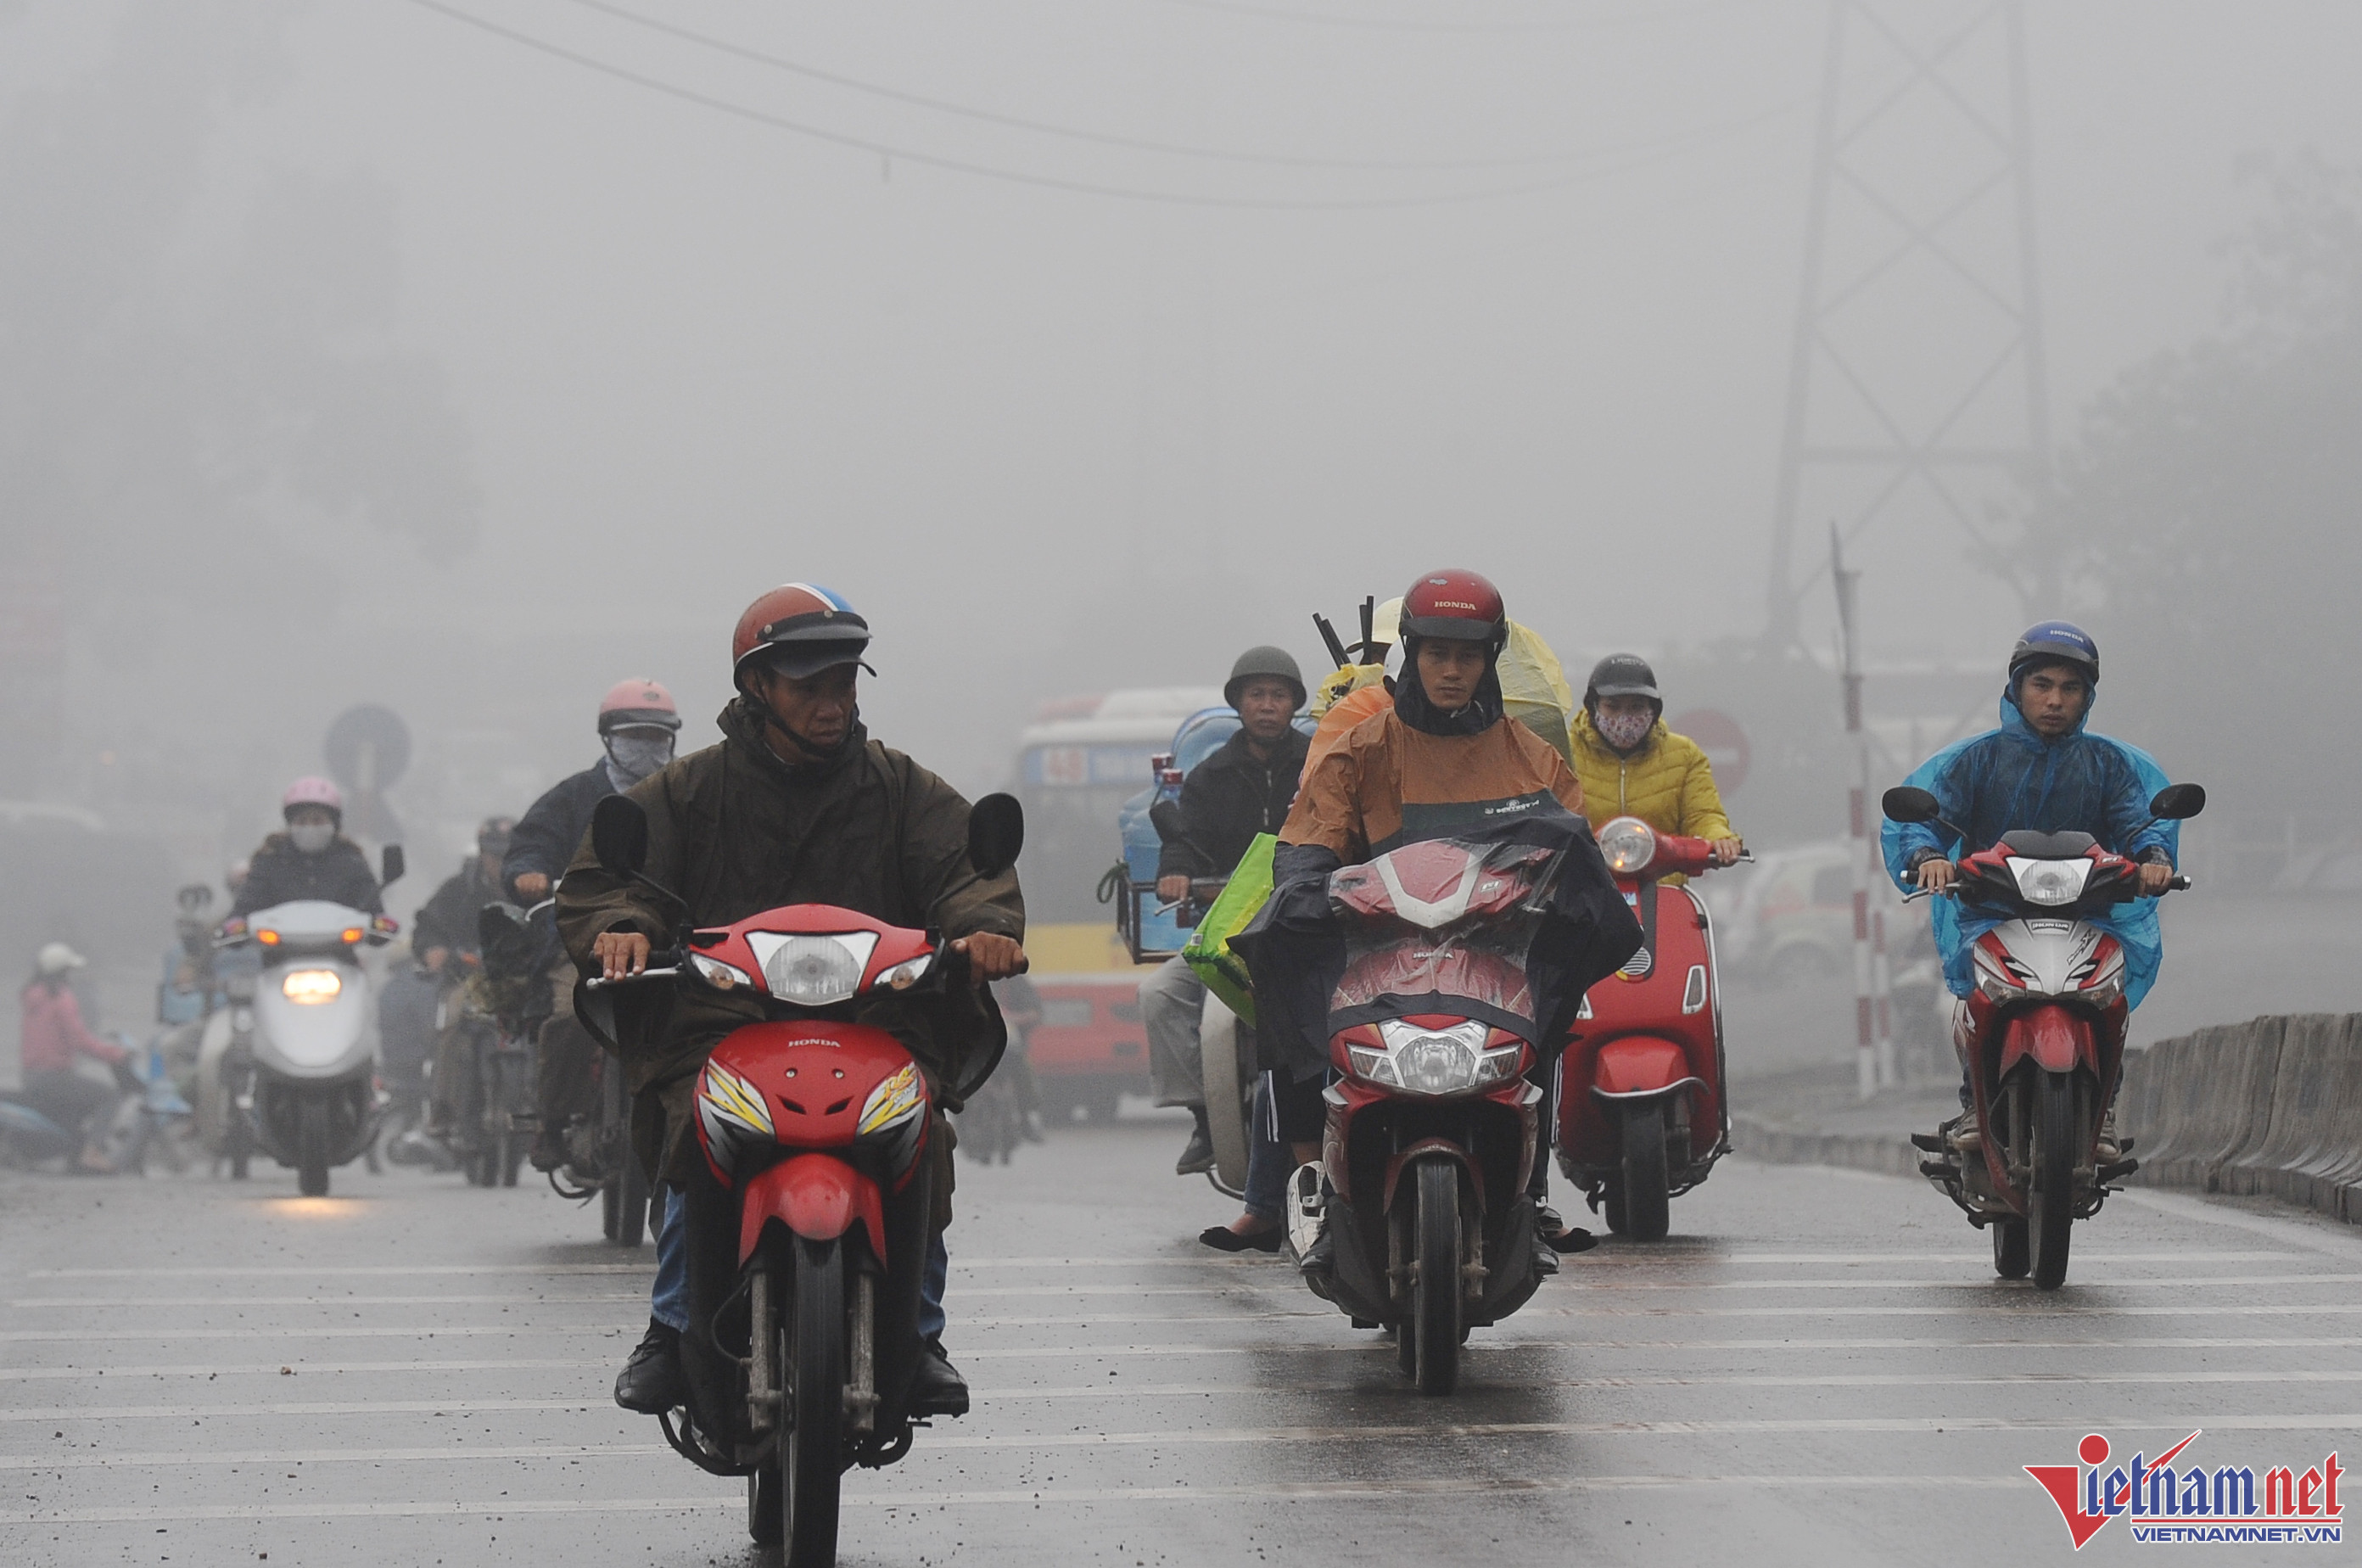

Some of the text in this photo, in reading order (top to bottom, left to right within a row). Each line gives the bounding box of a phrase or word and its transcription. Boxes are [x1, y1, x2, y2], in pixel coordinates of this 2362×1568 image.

[1434, 601, 1476, 610] HONDA
[2050, 630, 2084, 643] HONDA
[788, 1039, 841, 1048] HONDA
